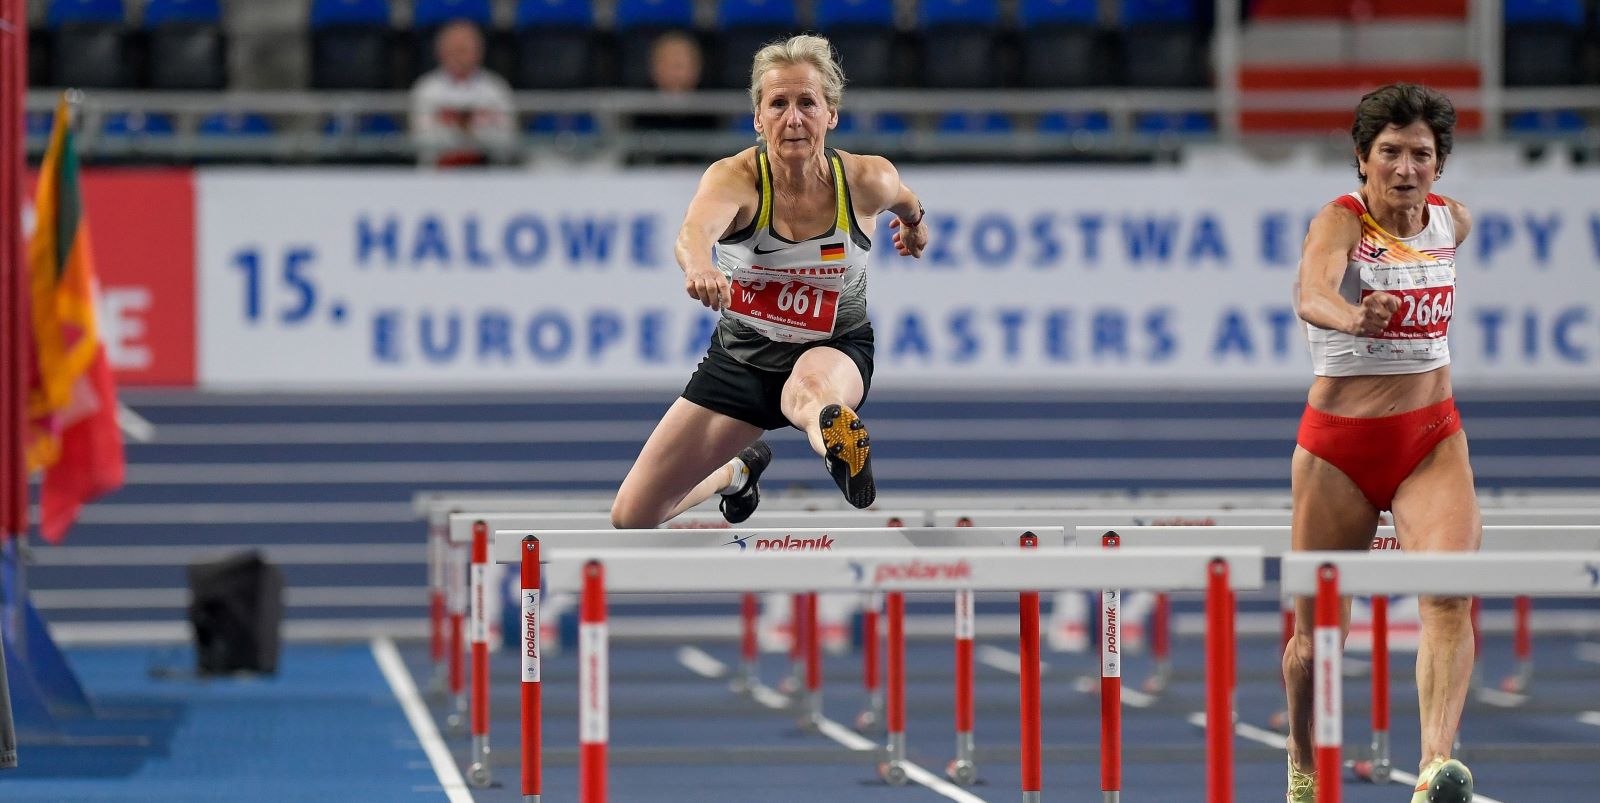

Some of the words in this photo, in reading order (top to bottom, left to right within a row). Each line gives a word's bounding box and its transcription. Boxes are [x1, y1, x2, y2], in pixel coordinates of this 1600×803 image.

[354, 212, 665, 267] HALOWE
[230, 246, 348, 326] 15.
[741, 289, 757, 305] W
[777, 281, 824, 318] 661
[750, 309, 762, 317] GER
[1400, 291, 1452, 327] 2664
[371, 308, 716, 362] EUROPEA
[866, 308, 1178, 363] ASTERS
[755, 535, 834, 551] polanik
[527, 611, 538, 659] polanik
[1106, 607, 1118, 654] polanik
